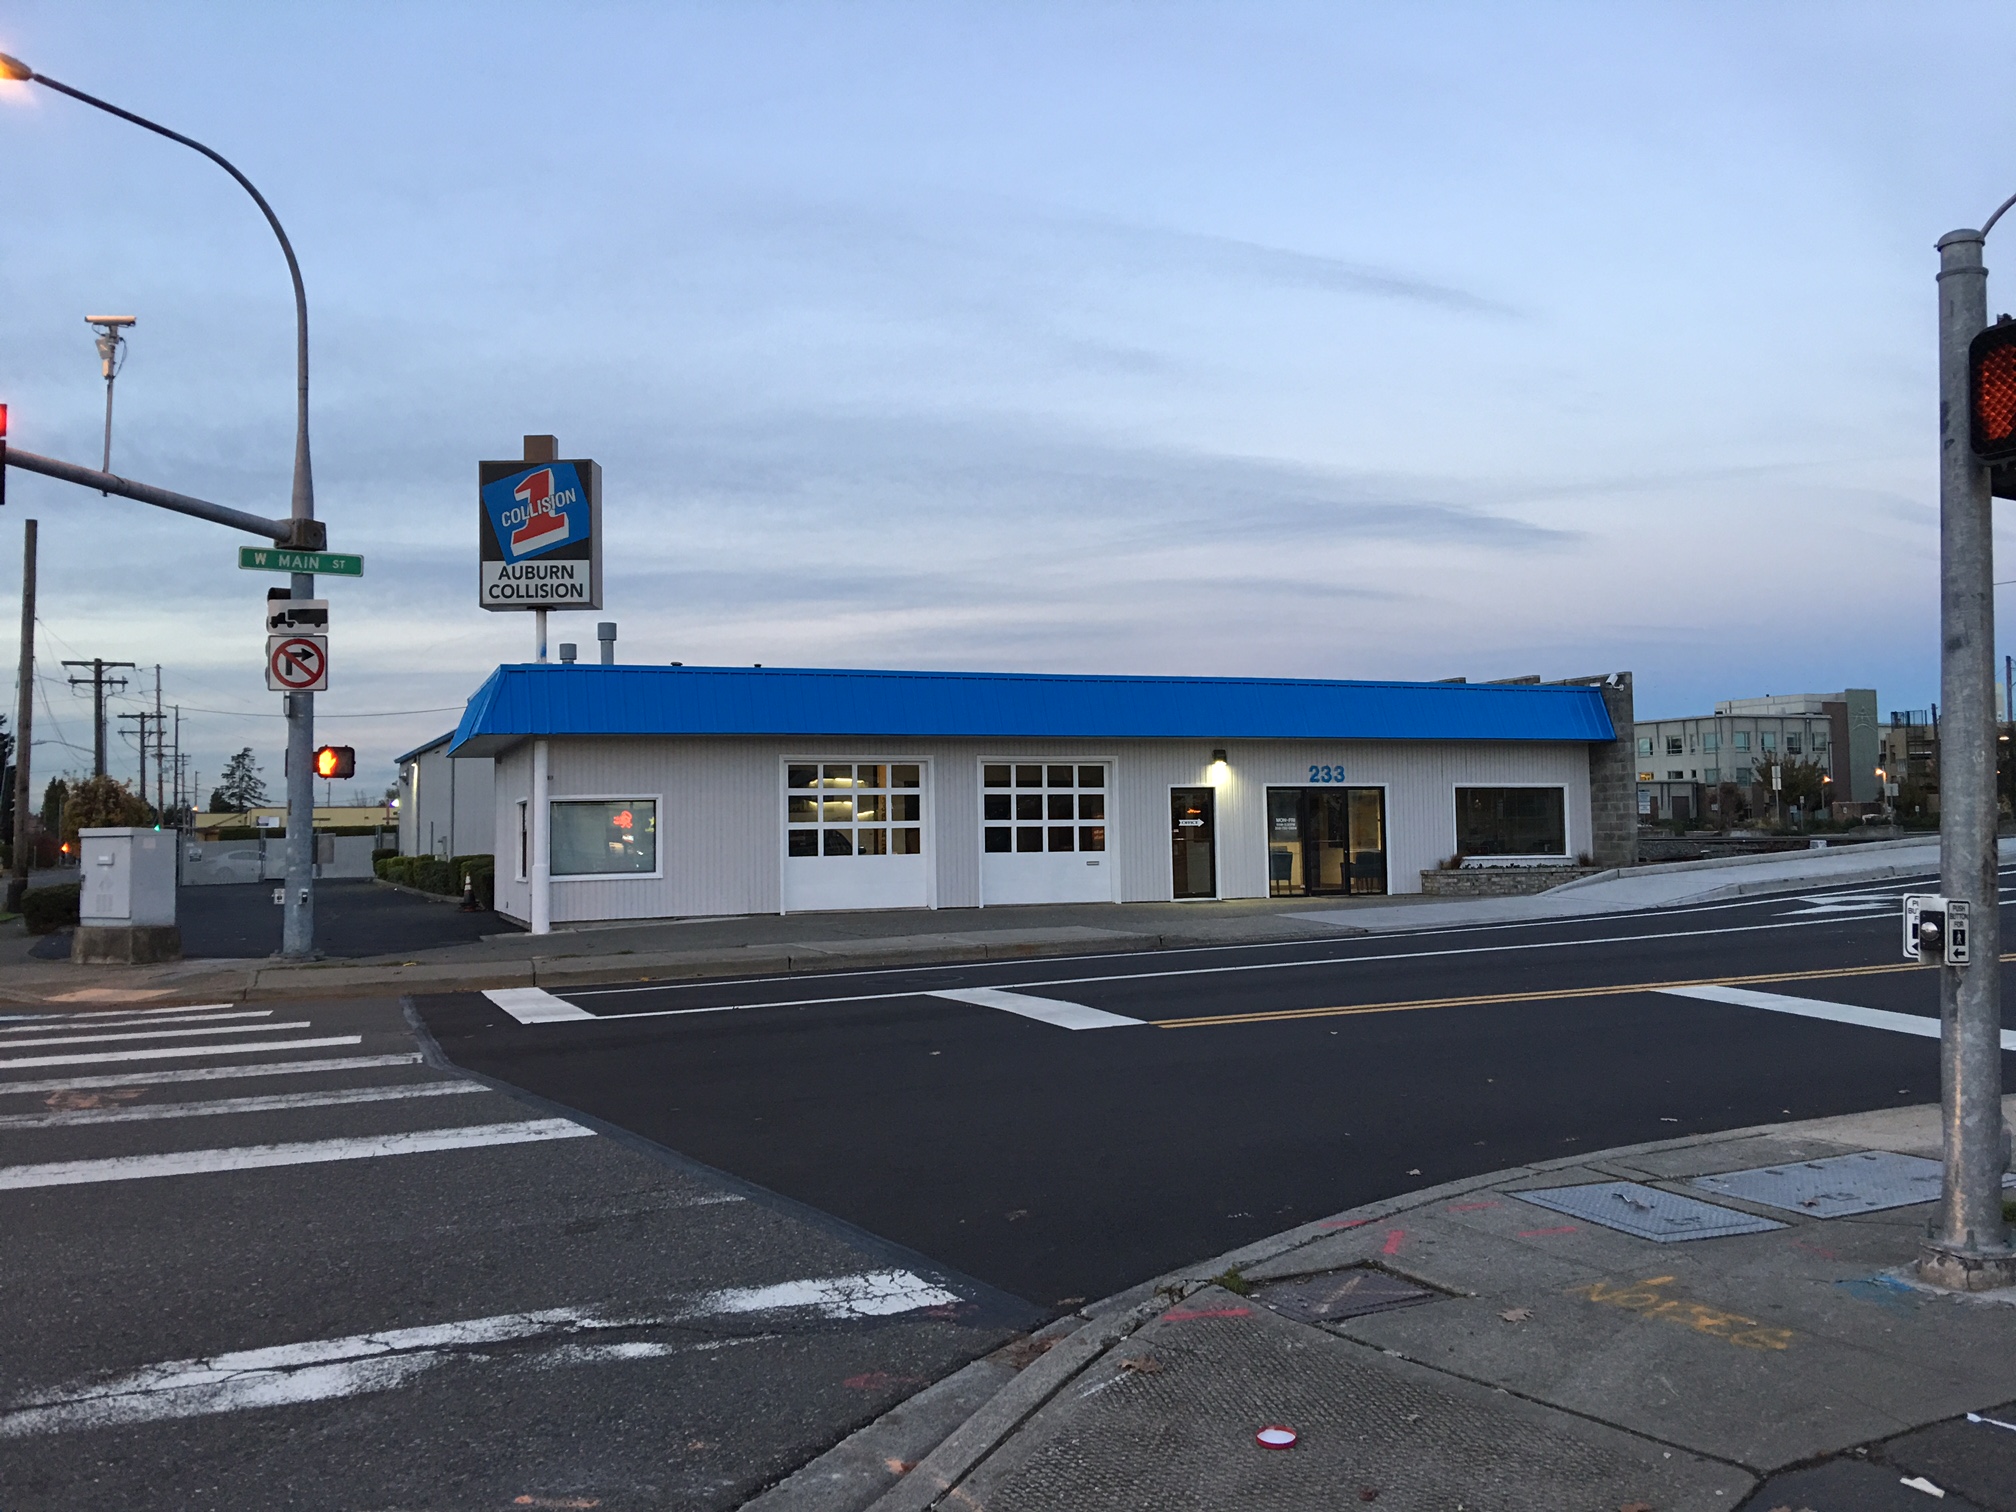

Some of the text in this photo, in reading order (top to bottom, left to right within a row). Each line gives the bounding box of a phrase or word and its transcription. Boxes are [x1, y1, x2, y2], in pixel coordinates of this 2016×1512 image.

[501, 487, 576, 527] COLLISION
[254, 552, 346, 569] W MAIN ST
[498, 564, 574, 580] AUBURN
[488, 583, 584, 599] COLLISION
[1309, 765, 1346, 783] 233
